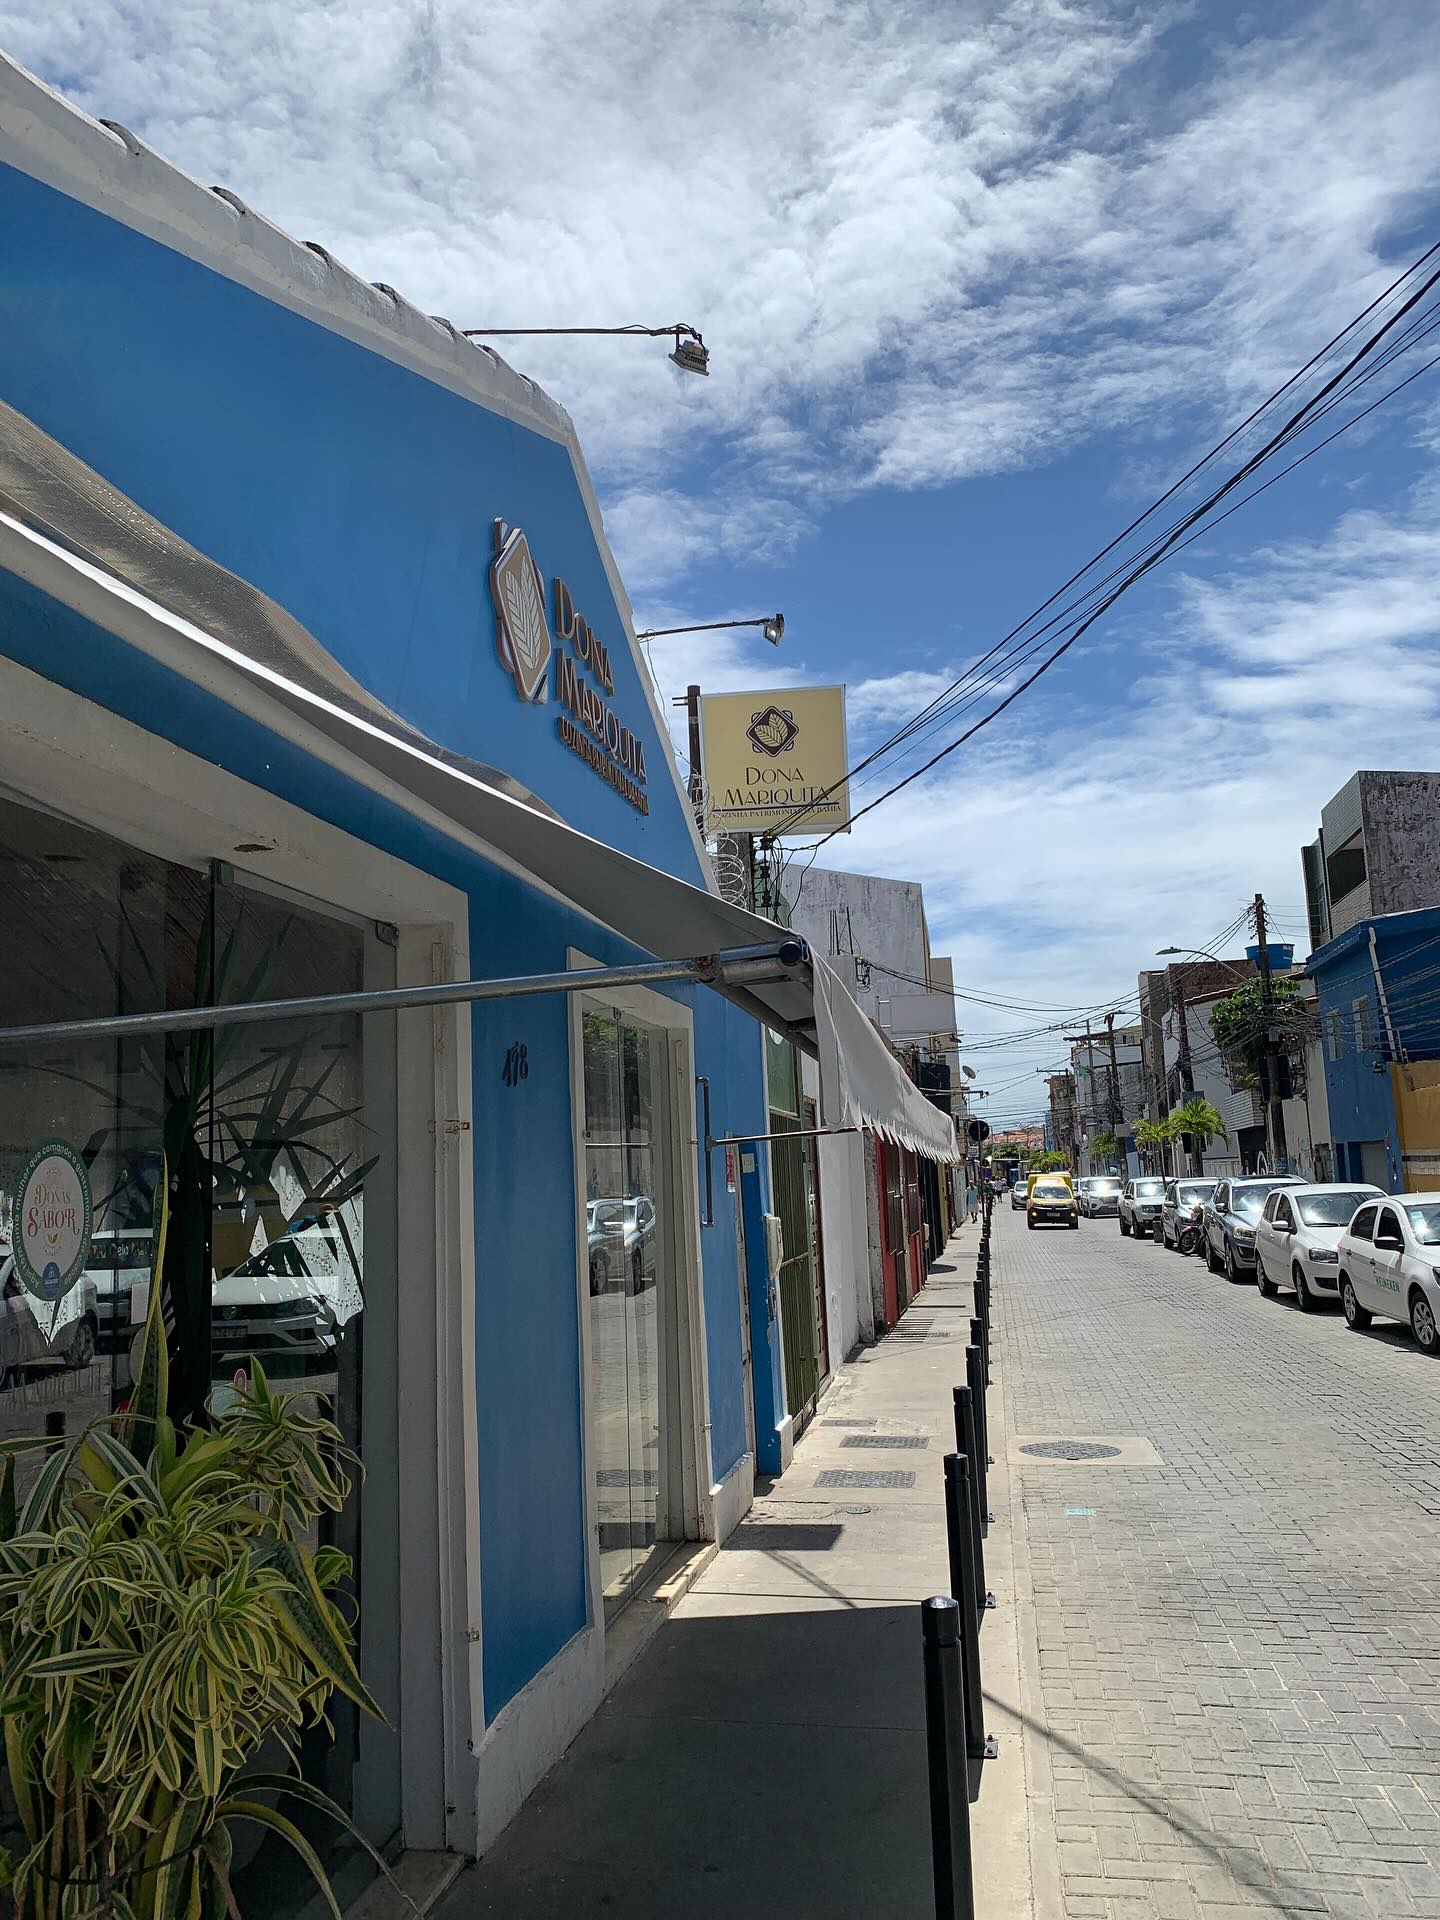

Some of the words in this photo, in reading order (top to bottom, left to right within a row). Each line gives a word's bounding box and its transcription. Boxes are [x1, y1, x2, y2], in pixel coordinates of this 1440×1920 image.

[555, 577, 615, 697] DONA
[556, 648, 647, 785] MARIQUITA
[746, 767, 804, 785] DONA
[724, 786, 829, 806] MARIQUITA
[750, 807, 803, 817] PATRIMONIA
[29, 1150, 42, 1168] que
